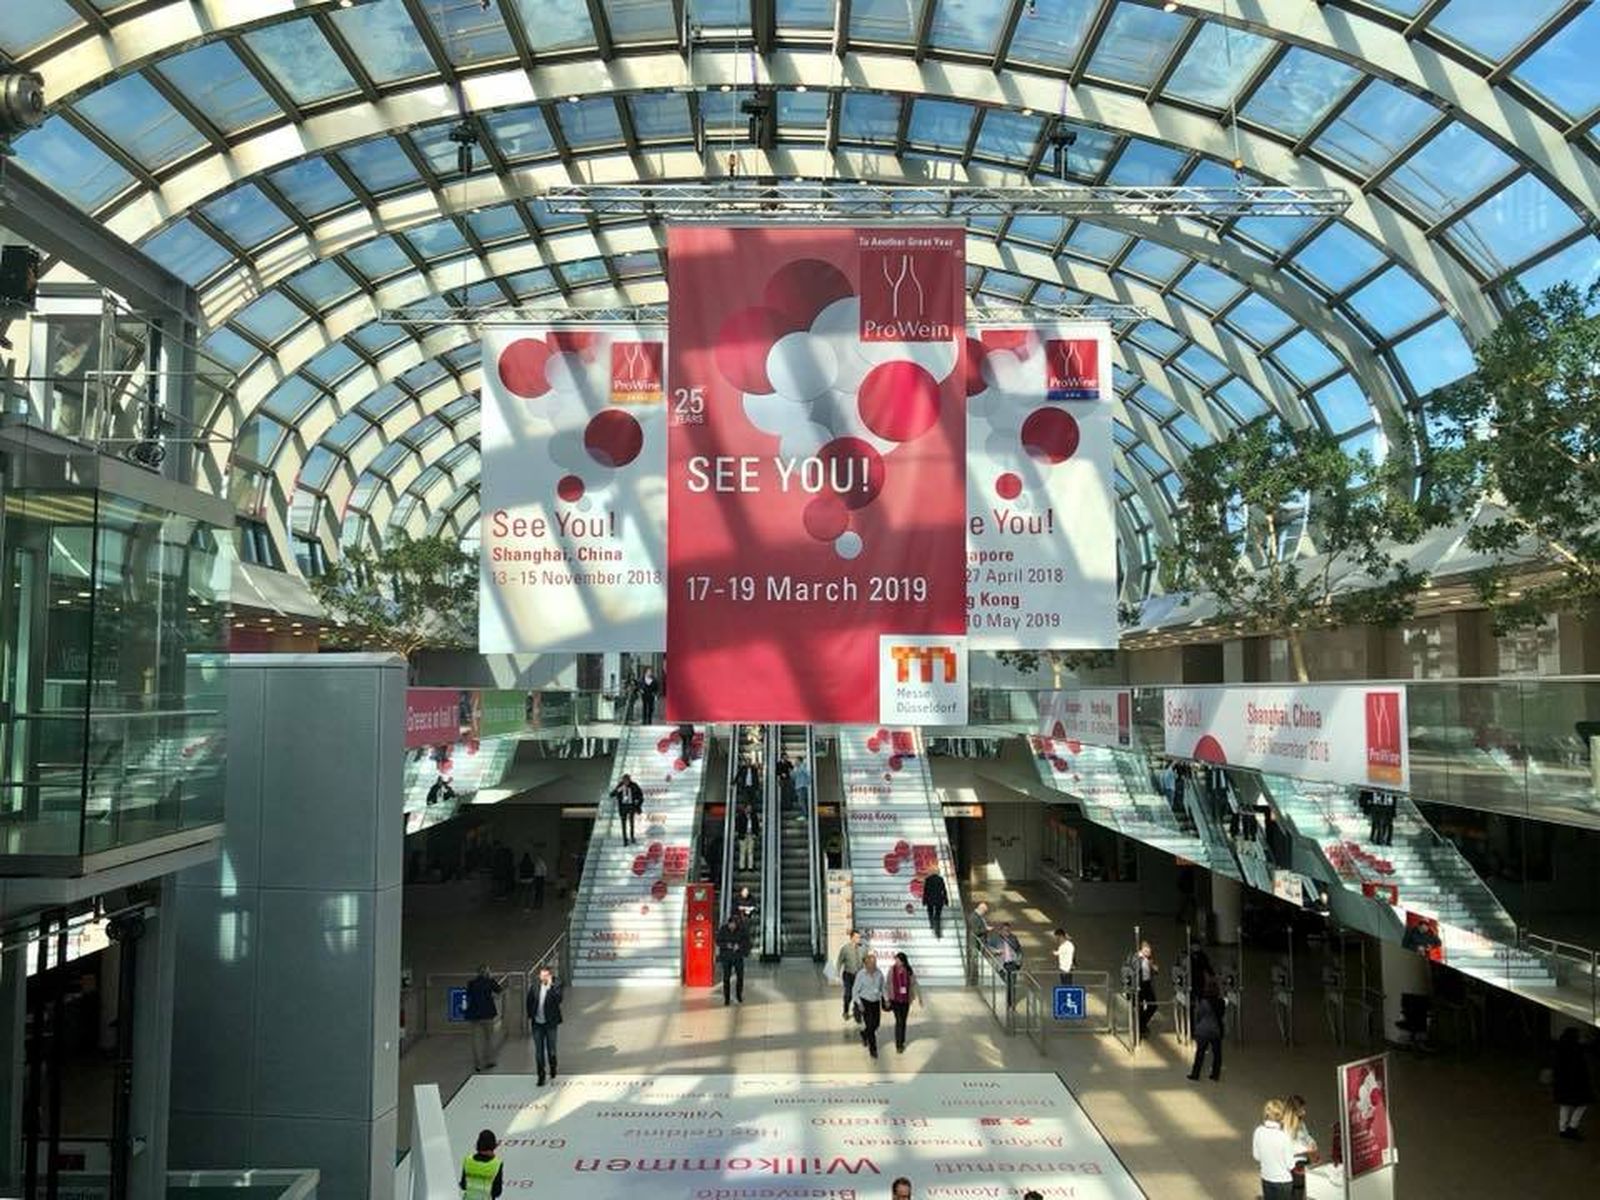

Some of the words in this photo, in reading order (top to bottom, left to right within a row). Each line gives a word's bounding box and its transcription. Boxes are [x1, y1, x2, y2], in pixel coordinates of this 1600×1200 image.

[864, 319, 950, 338] ProWein
[613, 379, 661, 391] ProWine
[674, 388, 704, 414] 25
[688, 456, 760, 492] SEE
[774, 456, 870, 492] YOU!
[493, 510, 545, 538] See
[555, 510, 616, 538] You!
[993, 508, 1053, 535] You!
[492, 547, 572, 565] Shanghai,
[577, 547, 623, 562] China
[543, 570, 622, 586] November
[627, 570, 662, 586] 2018
[986, 568, 1022, 586] April
[1027, 568, 1064, 583] 2018
[766, 576, 858, 601] March
[868, 576, 928, 601] 2019
[980, 592, 1020, 609] Kong
[986, 613, 1022, 631] May
[1025, 613, 1061, 628] 2019
[896, 701, 958, 713] Düsseldorf
[1293, 703, 1322, 728] China
[573, 1158, 881, 1175] Willkommen
